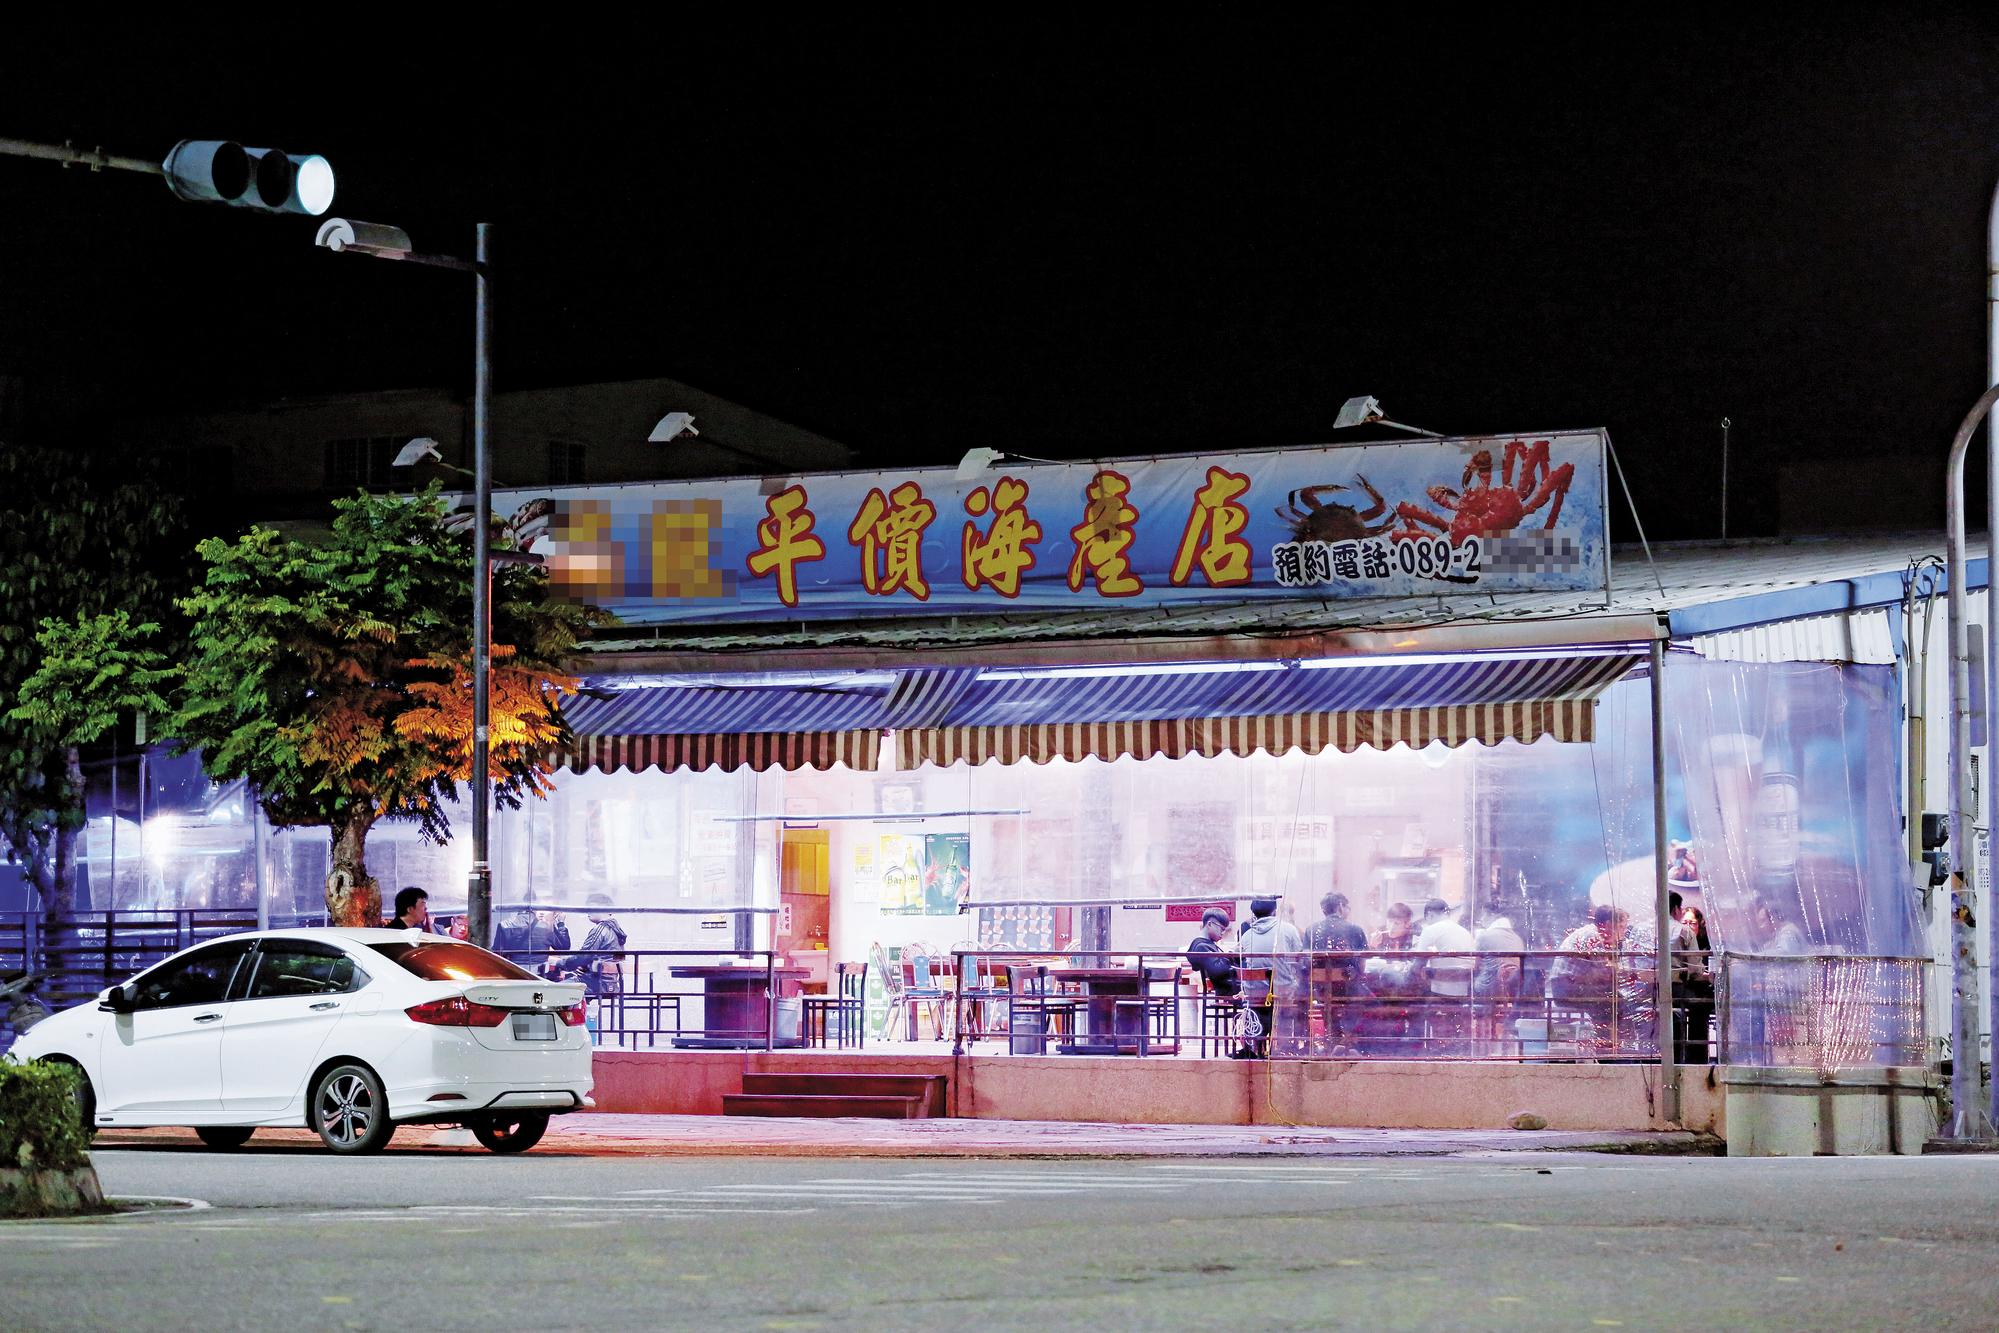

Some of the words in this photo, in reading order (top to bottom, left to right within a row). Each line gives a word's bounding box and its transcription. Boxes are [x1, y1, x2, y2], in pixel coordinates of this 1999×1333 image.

[553, 466, 1253, 608] 平價海產店
[1275, 534, 1577, 582] 預約電話:089-2
